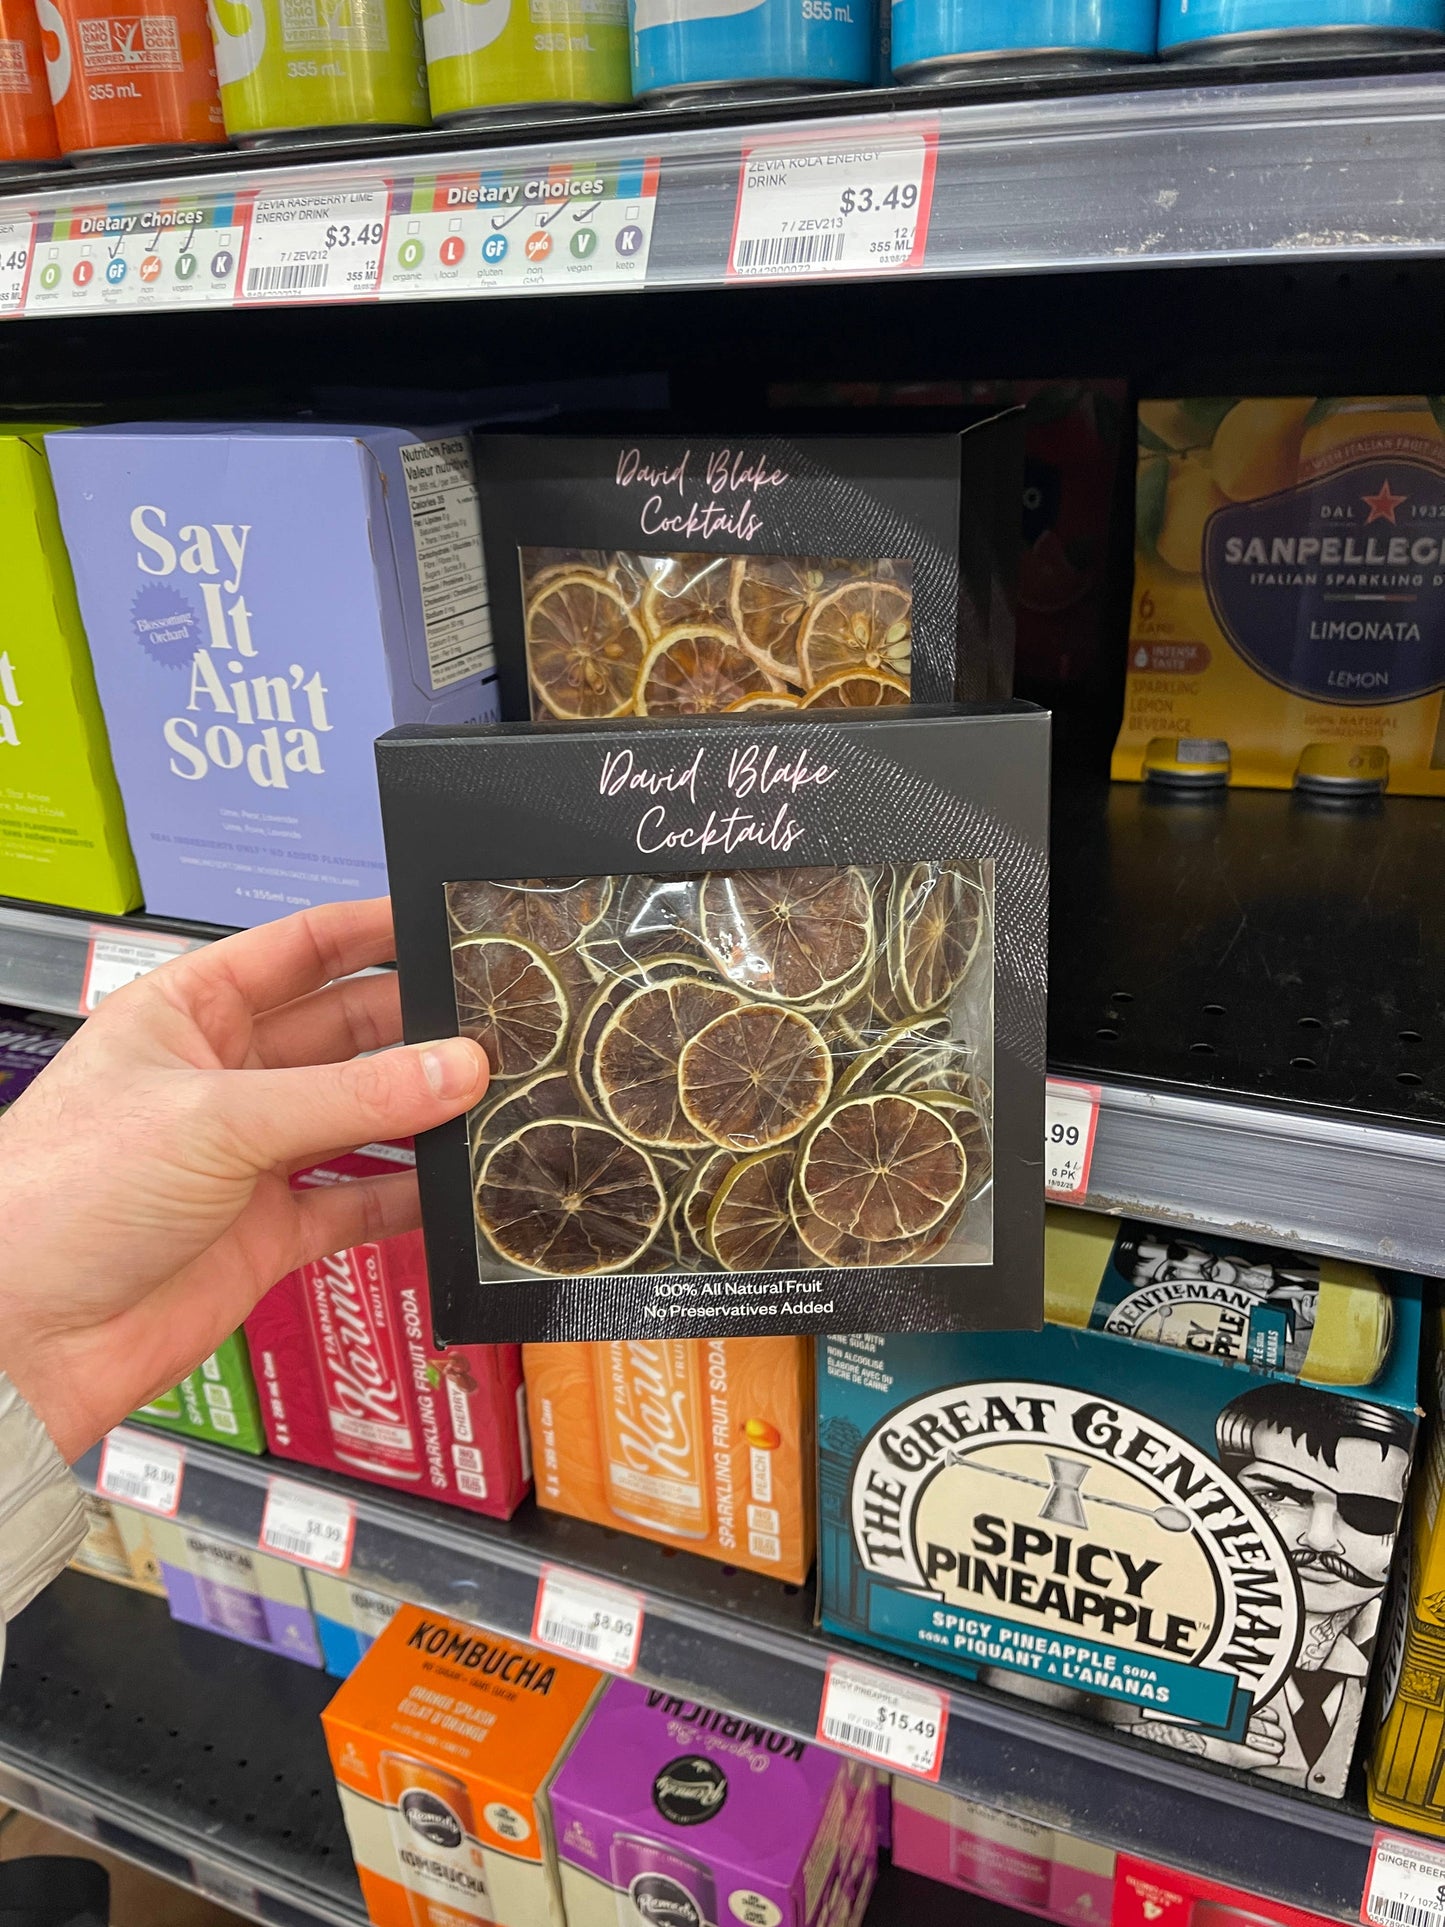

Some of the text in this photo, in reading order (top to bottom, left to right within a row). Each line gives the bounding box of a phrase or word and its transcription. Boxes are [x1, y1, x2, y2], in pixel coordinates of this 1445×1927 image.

[802, 2, 854, 24] 355 mL
[83, 33, 107, 43] GMO
[145, 28, 174, 38] SANS
[146, 38, 176, 49] OGM
[534, 34, 566, 52] 355
[85, 53, 125, 66] VERIFIED
[287, 61, 317, 78] 355
[89, 82, 142, 100] 355 mL
[447, 178, 604, 206] Dietary Choices
[748, 174, 787, 188] DRINK
[839, 184, 918, 217] $3.49
[80, 210, 203, 235] Dietary Choices
[256, 208, 330, 224] ENERGY DRINK
[781, 217, 843, 232] 7 ZEV213
[325, 223, 384, 250] $3.49
[894, 228, 909, 239] 12
[293, 250, 328, 261] ZEV212
[486, 241, 505, 257] GF
[870, 241, 891, 253] 355
[108, 264, 124, 279] GF
[346, 272, 363, 281] 355
[392, 261, 635, 282] organic local gluten non vegan keto
[402, 441, 463, 463] Nutrition Facts
[406, 466, 433, 480] Valeur
[616, 448, 789, 497] David Blake
[641, 496, 764, 541] Cocktails
[1321, 505, 1353, 518] DAL
[130, 505, 252, 593] Say
[1251, 573, 1423, 588] ITALIAN SPARKLING
[1140, 590, 1154, 619] 6
[136, 611, 194, 633] Blossoming
[199, 582, 258, 657] It
[149, 626, 190, 645] Orchard
[1310, 621, 1420, 642] LIMONATA
[186, 648, 334, 732] Ain't
[1327, 670, 1389, 688] LEMON
[1130, 697, 1173, 713] LEMON
[163, 717, 325, 789] Soda
[600, 745, 838, 804] David Blake
[636, 803, 805, 855] Cocktails
[1051, 1168, 1075, 1181] 6 PK
[1065, 1161, 1071, 1169] 4
[366, 1254, 386, 1329] FRUIT CO.
[654, 1279, 823, 1298] 100% All Natural Fruit
[312, 1278, 337, 1354] FARMING
[643, 1300, 834, 1319] No Preservatives Added
[849, 1337, 876, 1353] SUGAR
[863, 1333, 885, 1346] WITH
[827, 1345, 885, 1371] NON ALCOOLISÉ
[827, 1366, 889, 1393] SUCRE DE CANNE
[861, 1368, 881, 1381] AVEC
[881, 1374, 894, 1385] DU
[400, 1288, 449, 1489] SPARKLING FRUIT SODA
[452, 1389, 470, 1437] CHERRY
[708, 1340, 736, 1549] SPARKLING FRUIT SODA
[878, 1395, 1056, 1473] GREAT
[754, 1454, 768, 1498] PEACH
[861, 1470, 907, 1567] THE
[307, 1519, 340, 1541] $8.99
[1072, 1400, 1284, 1683] GENTLEMAN
[971, 1512, 1163, 1598] SPICY
[926, 1541, 1200, 1657] PINEAPPLE
[593, 1612, 633, 1637] $8.99
[409, 1620, 556, 1696] KOMBUCHA
[932, 1611, 1158, 1683] SPICY PINEAPPLE SODA
[918, 1629, 1171, 1703] SODA PIQUANT L'ANANAS
[877, 1706, 936, 1739] $15.49
[400, 1849, 486, 1894] KOMBUCHA
[1378, 1852, 1417, 1870] GINGER
[637, 1893, 697, 1922] Remedy
[1400, 1892, 1445, 1911] 17 10723
